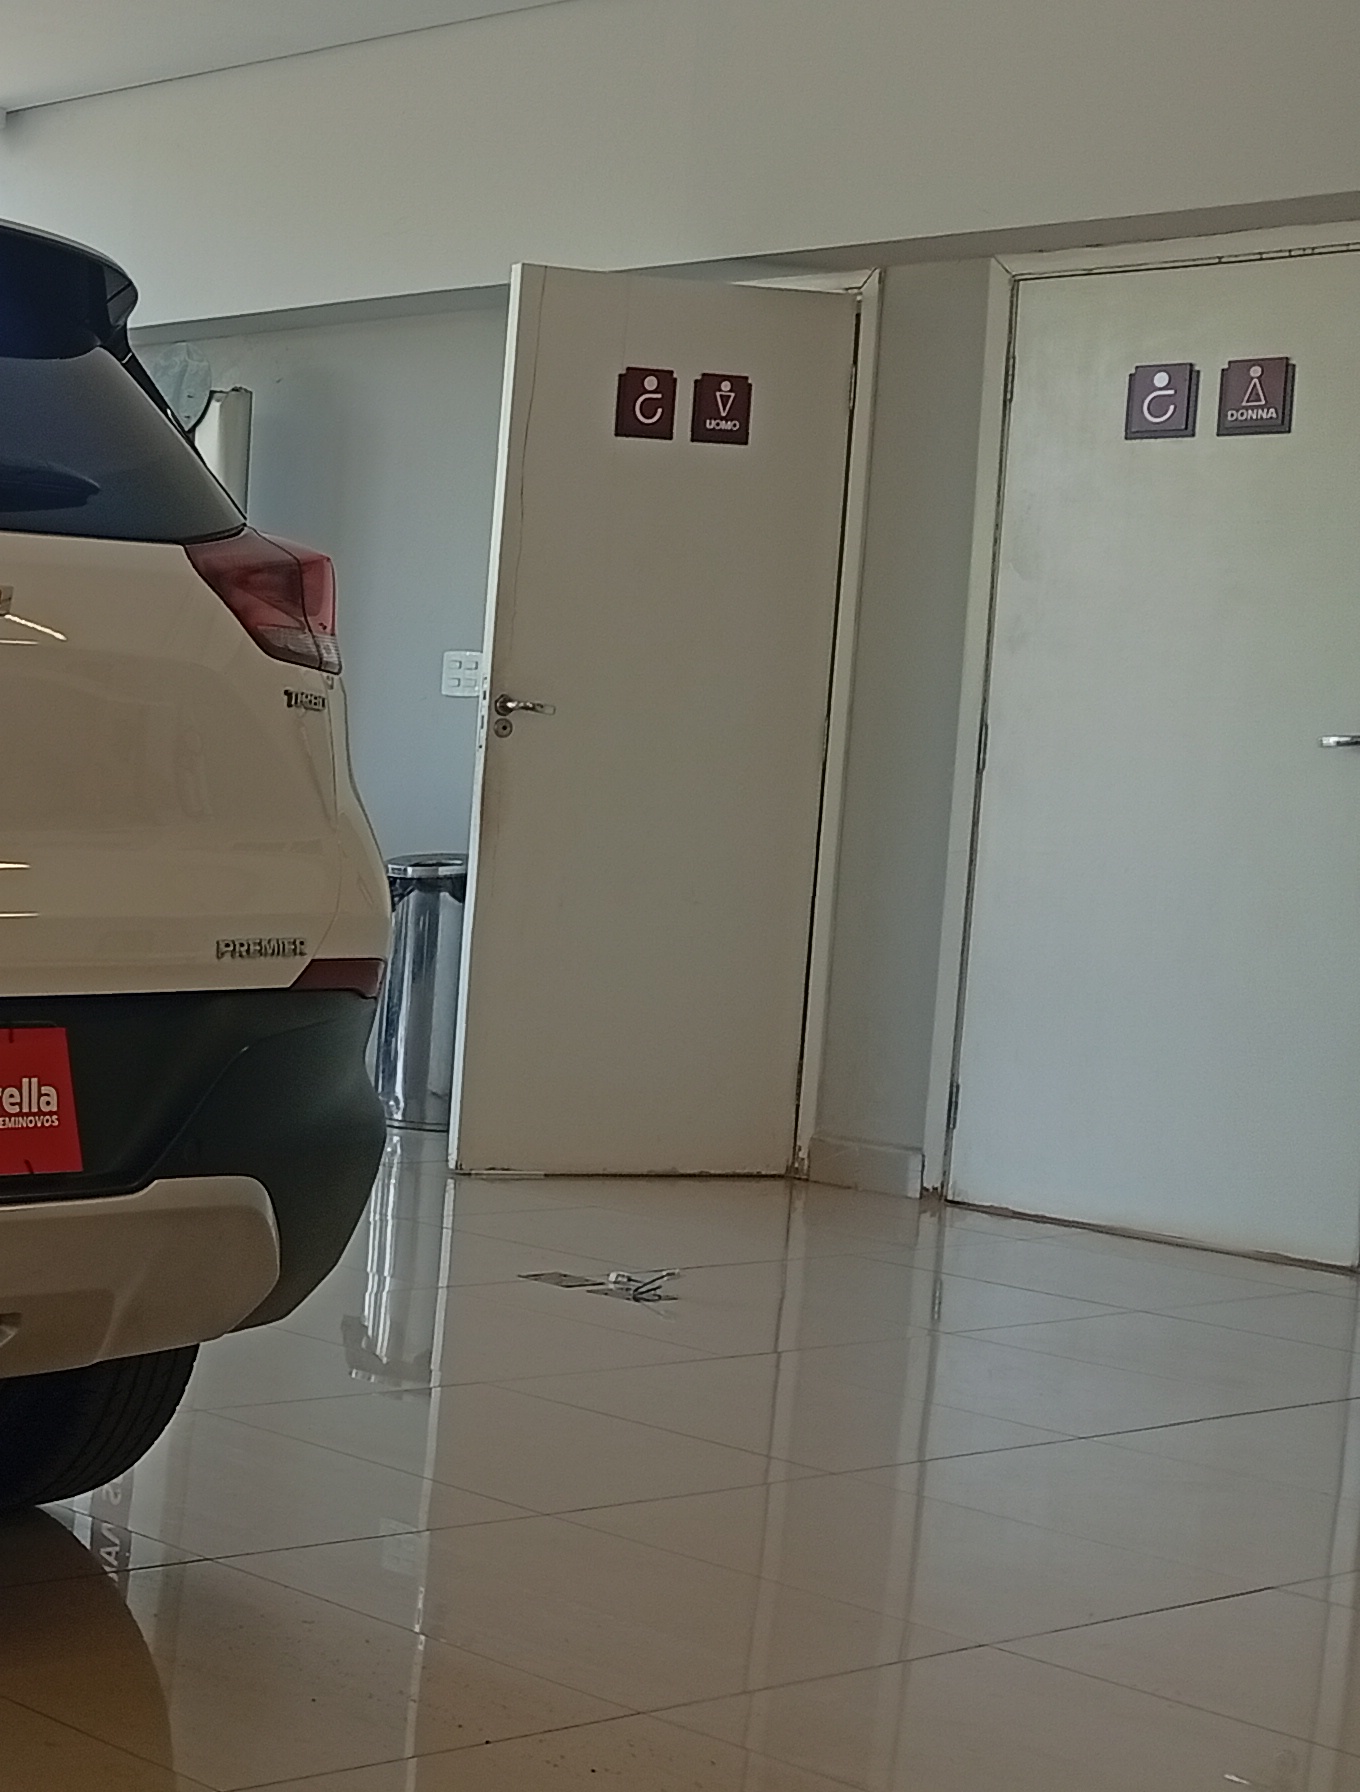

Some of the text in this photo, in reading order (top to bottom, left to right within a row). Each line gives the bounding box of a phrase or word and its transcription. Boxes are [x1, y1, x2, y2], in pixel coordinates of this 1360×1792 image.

[1227, 408, 1278, 421] DONNA
[705, 419, 740, 431] UOMO
[216, 938, 308, 960] PREMIER
